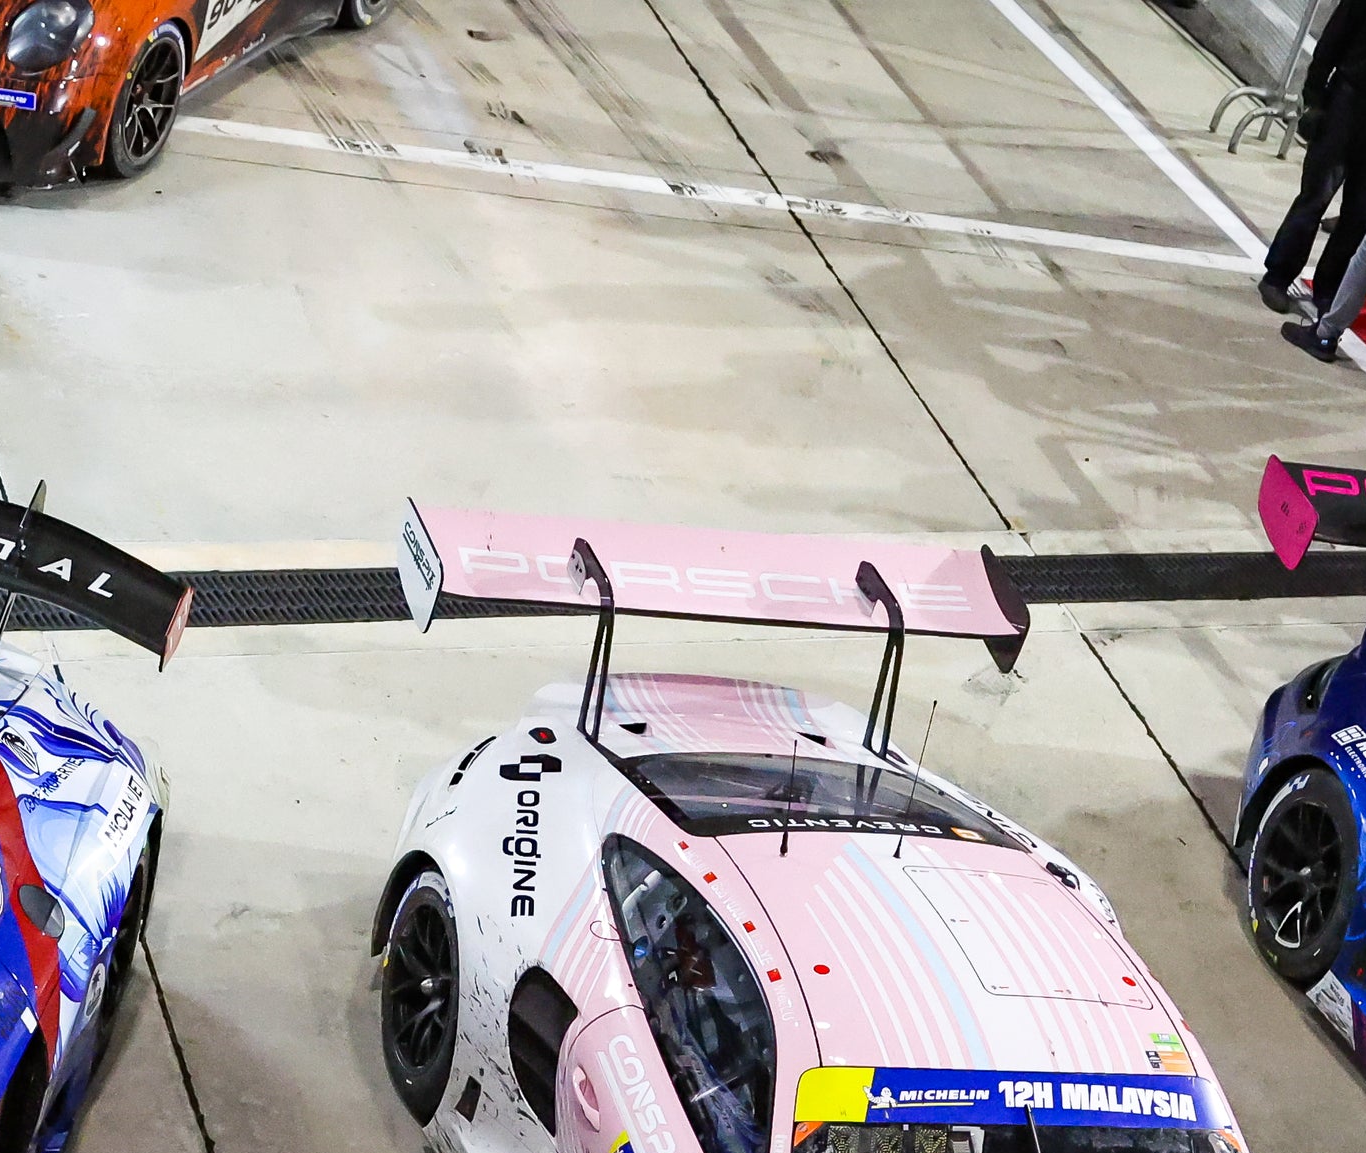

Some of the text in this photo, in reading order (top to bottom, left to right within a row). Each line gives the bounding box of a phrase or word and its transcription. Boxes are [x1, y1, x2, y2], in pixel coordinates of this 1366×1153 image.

[457, 545, 973, 614] PORSCHE
[747, 817, 943, 835] CREVENTIC
[502, 789, 540, 917] ORIGINE
[898, 1086, 990, 1102] MICHELIN
[997, 1079, 1198, 1122] 12H MALAYSIA
